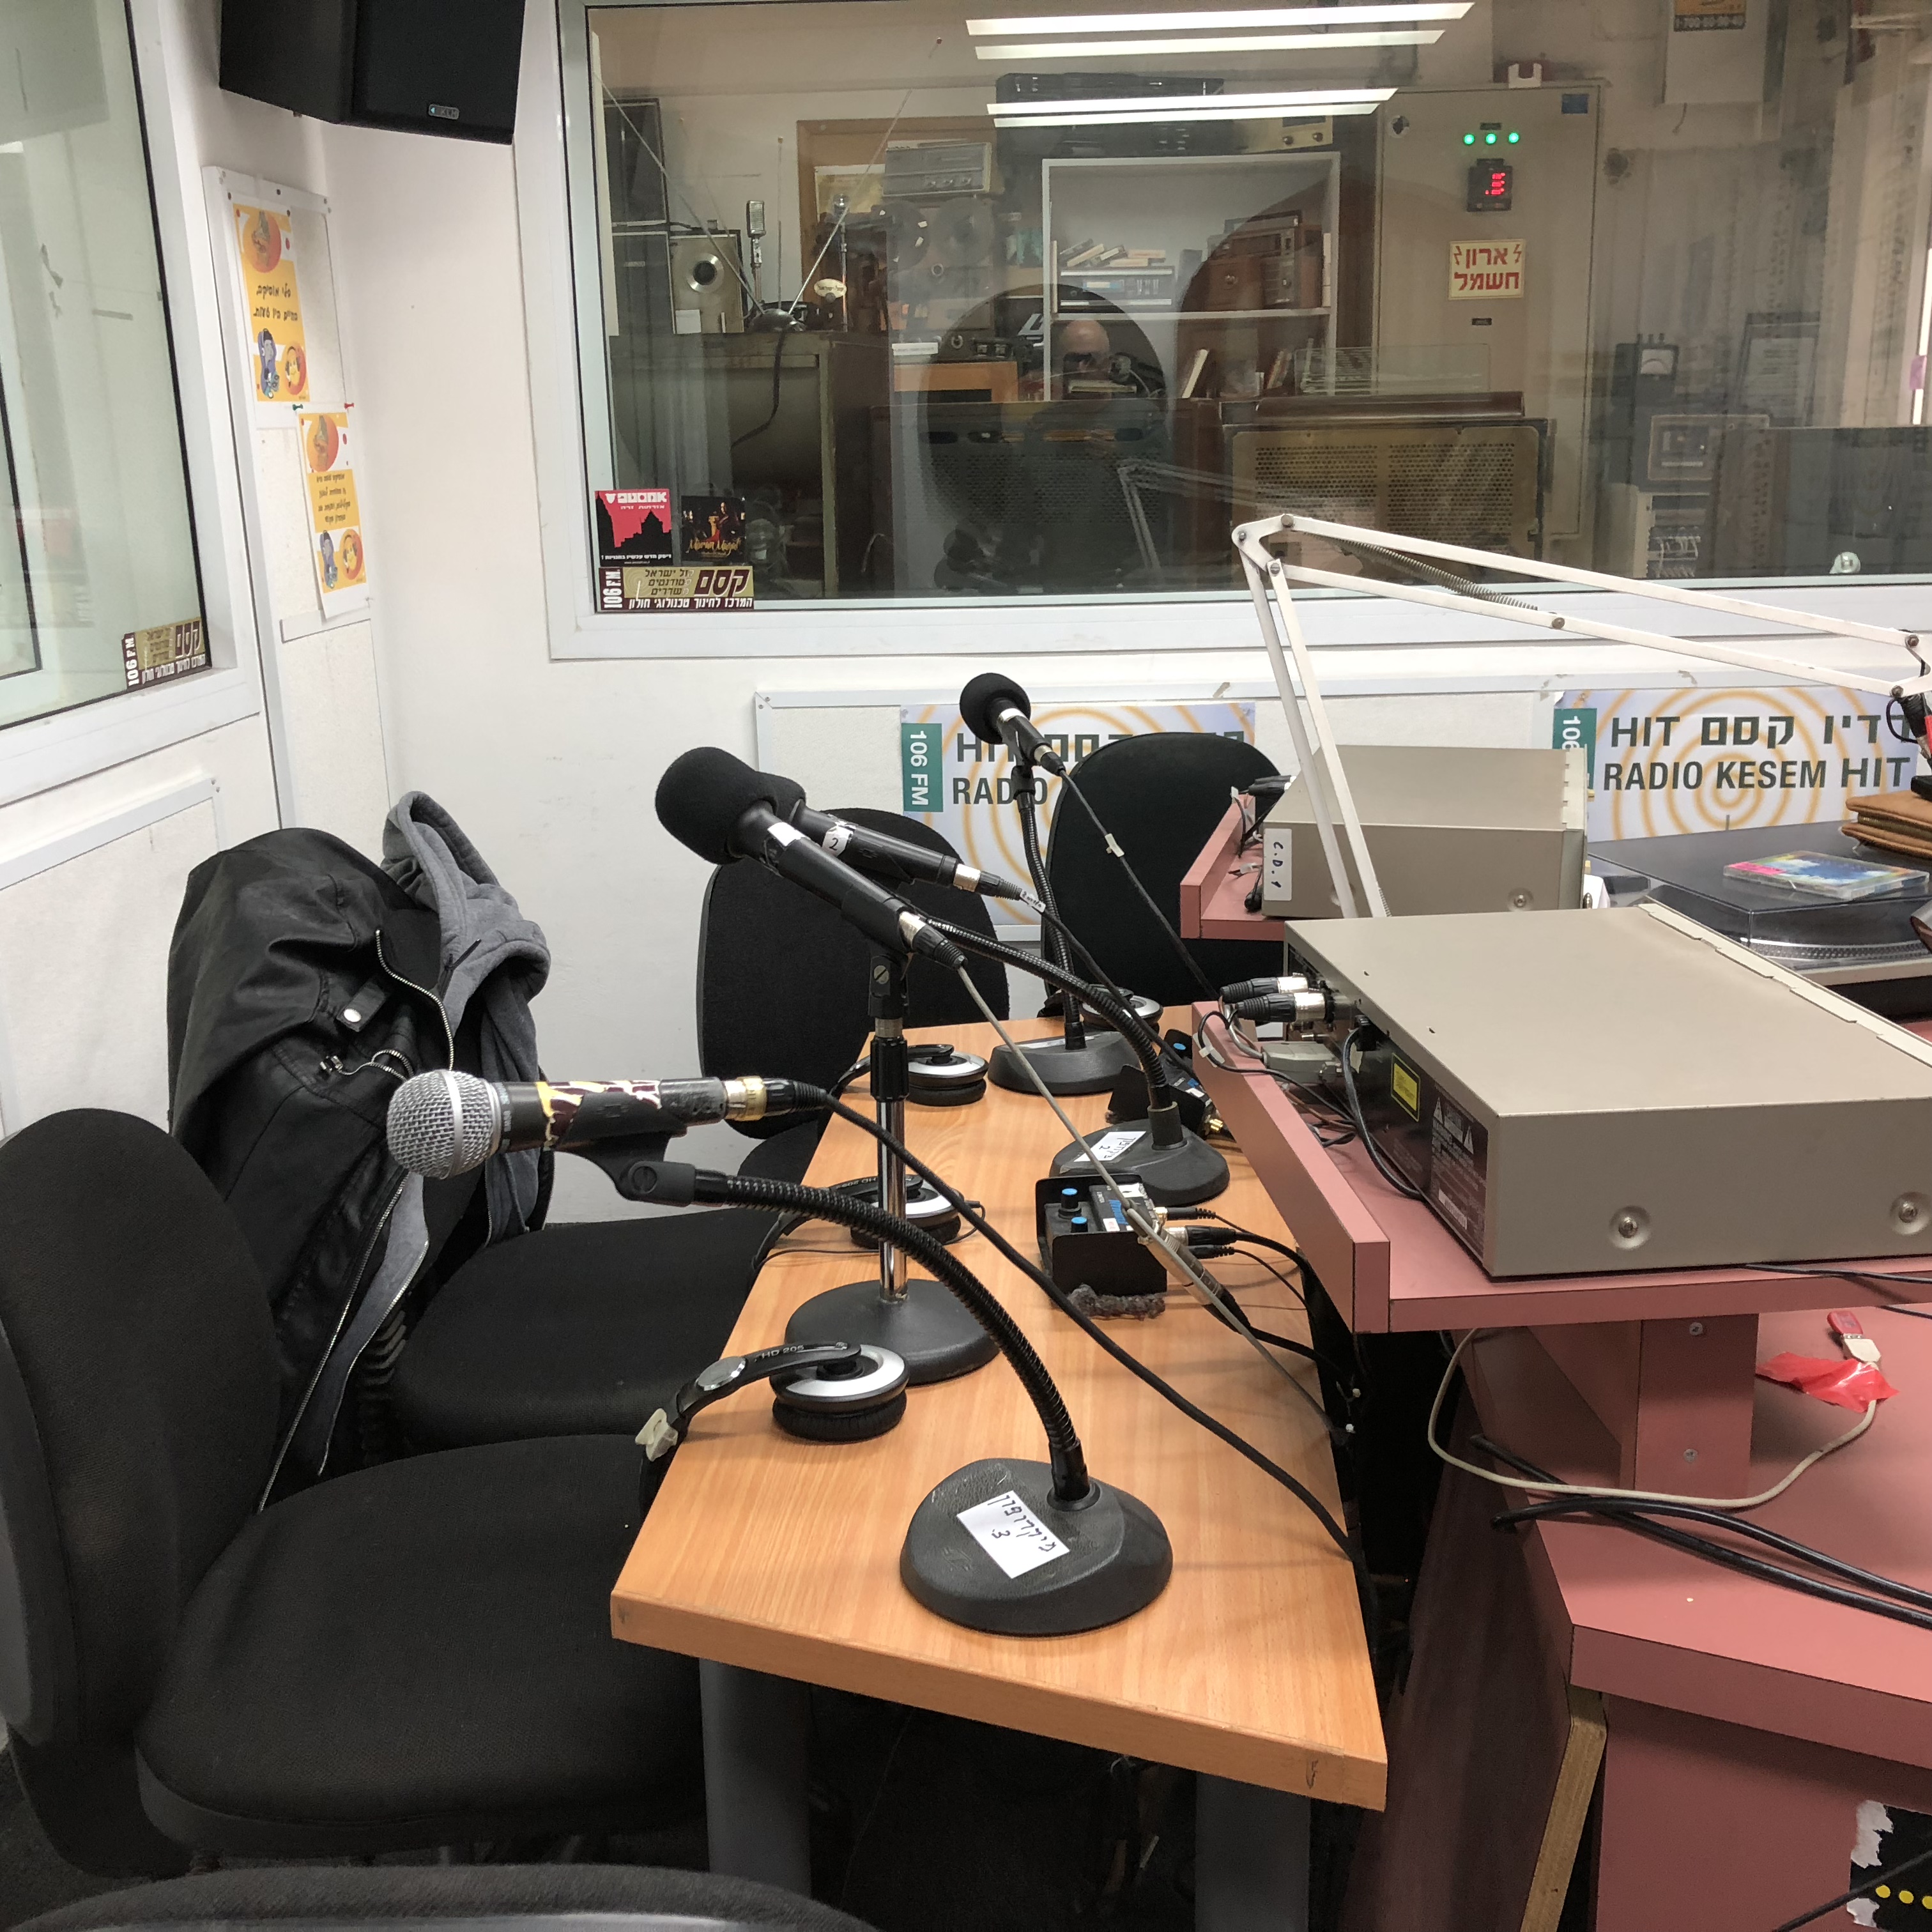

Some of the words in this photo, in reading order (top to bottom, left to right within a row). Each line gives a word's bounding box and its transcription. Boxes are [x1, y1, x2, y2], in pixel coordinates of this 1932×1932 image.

[1466, 248, 1508, 268] ארון
[1454, 272, 1519, 291] חשמל
[694, 569, 750, 597] קסם
[603, 588, 623, 609] 106
[629, 598, 650, 610] חולון
[654, 598, 689, 608] טכנולוגי
[694, 598, 721, 609] לחינוך
[724, 597, 753, 608] המרכז
[1611, 716, 1680, 747] HIT
[1701, 716, 1795, 749] קסם
[910, 730, 928, 767] 106
[1604, 761, 1703, 791] RADIO
[1716, 760, 1827, 790] KESEM
[1841, 757, 1911, 787] HIT
[911, 774, 928, 805] FM
[953, 778, 1048, 805] RADO
[829, 838, 839, 850] 2
[762, 1349, 780, 1359] HD
